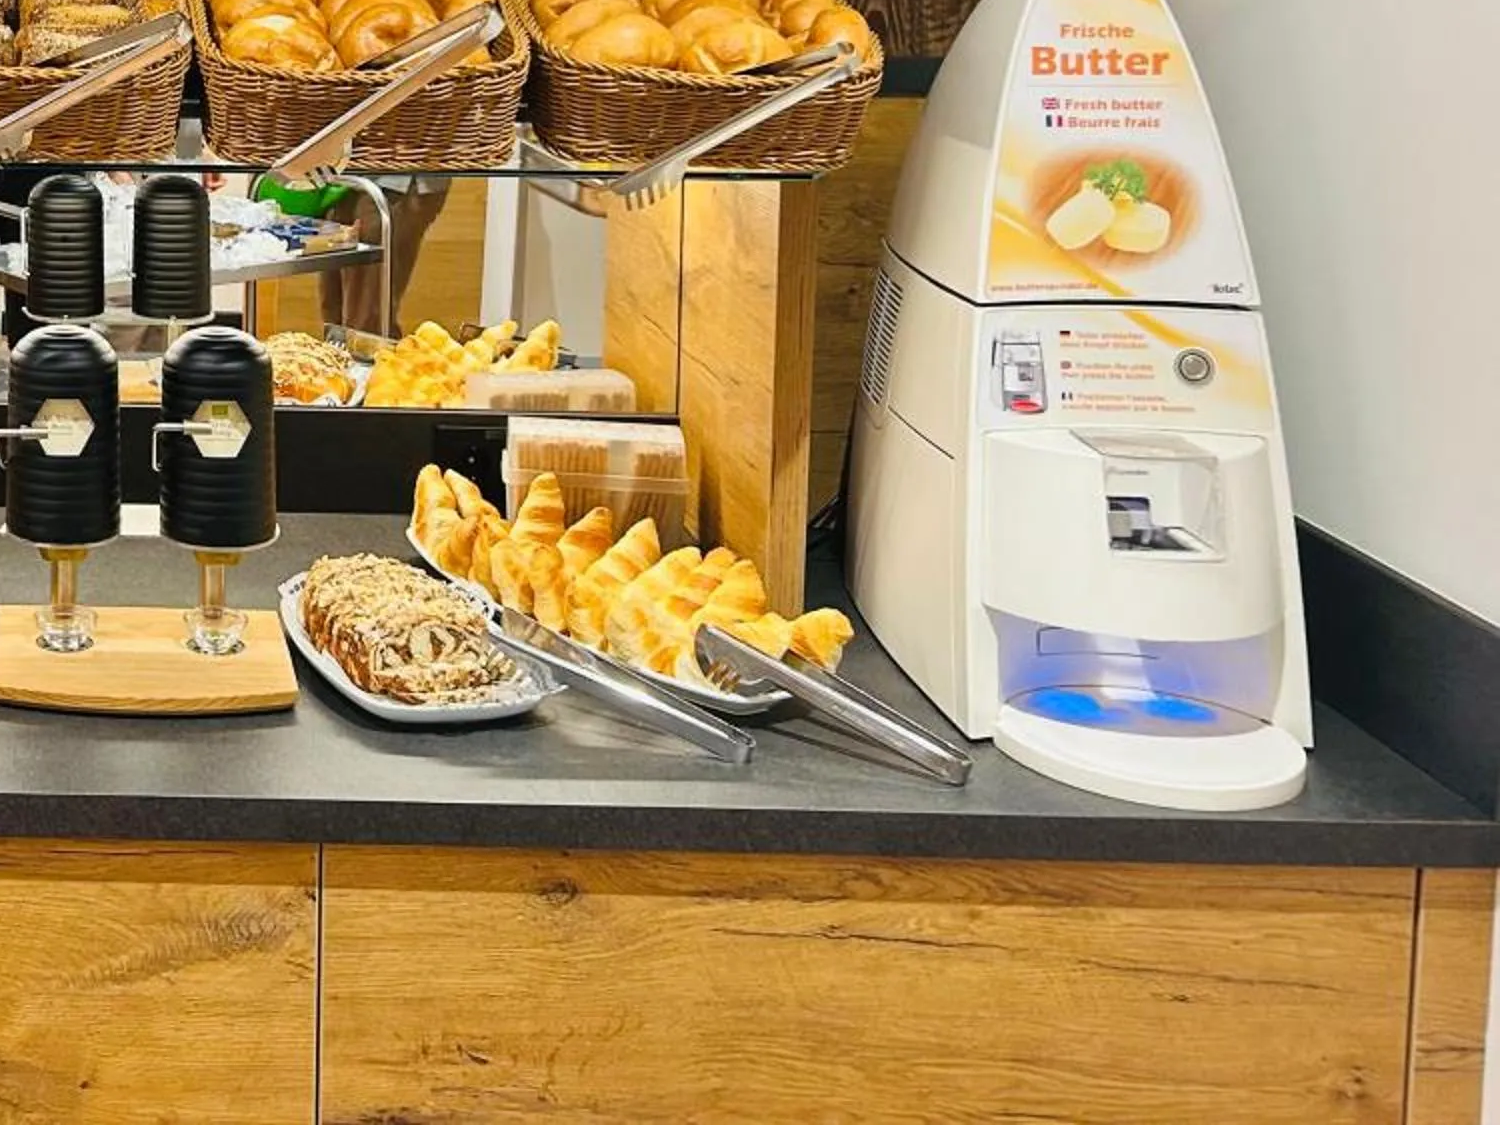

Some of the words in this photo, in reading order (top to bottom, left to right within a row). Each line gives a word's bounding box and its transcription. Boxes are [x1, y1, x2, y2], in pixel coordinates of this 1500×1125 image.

[1059, 24, 1135, 39] Frische
[1030, 46, 1170, 76] Butter
[1064, 98, 1108, 111] Fresh
[1111, 98, 1164, 111] butter
[1067, 116, 1122, 129] Beurre
[1124, 116, 1161, 129] frais
